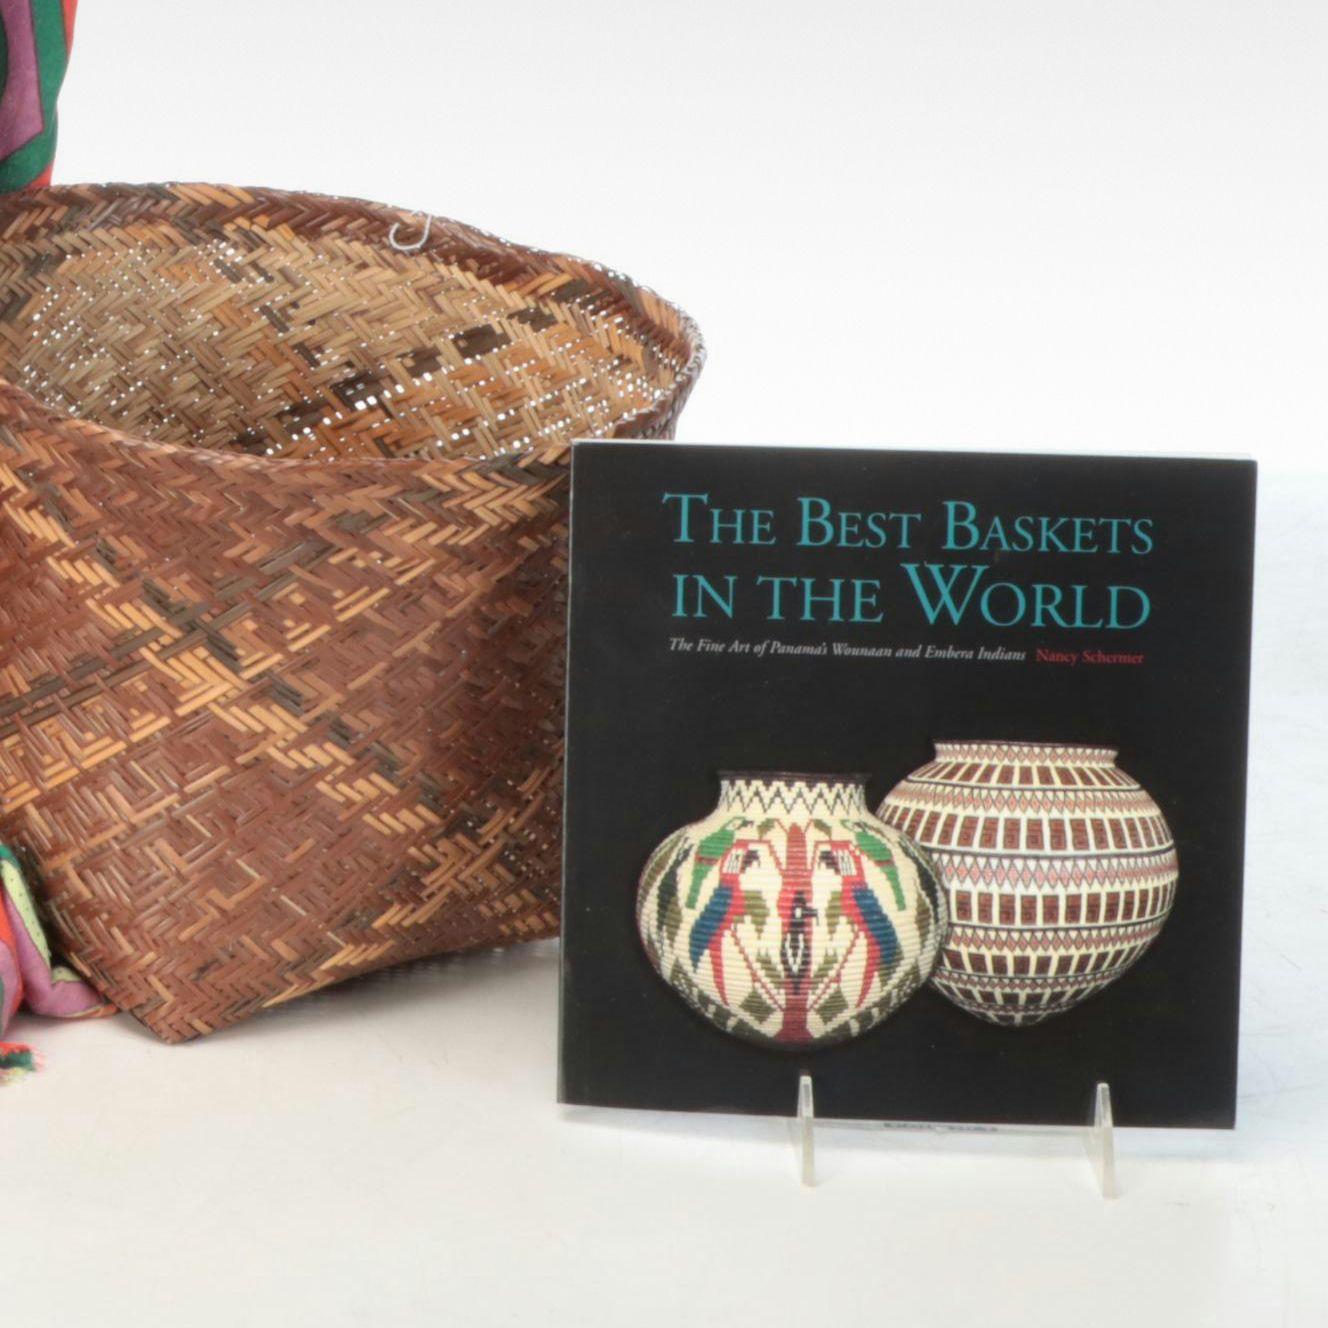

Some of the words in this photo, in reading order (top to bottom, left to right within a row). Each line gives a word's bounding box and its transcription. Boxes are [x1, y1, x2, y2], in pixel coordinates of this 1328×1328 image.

[662, 493, 777, 545] THE
[795, 496, 921, 550] BEST
[942, 500, 1154, 555] BASKETS
[672, 574, 737, 618] IN
[757, 576, 884, 624] THE
[900, 562, 1152, 631] WORLD
[669, 637, 694, 652] The
[696, 638, 726, 653] Fine
[728, 639, 750, 654] Art
[753, 639, 771, 658] of
[832, 642, 893, 657] Wounaan
[895, 644, 923, 658] and
[977, 646, 1027, 661] Indians
[1036, 648, 1079, 665] Nancy
[1081, 650, 1145, 665] Schermer
